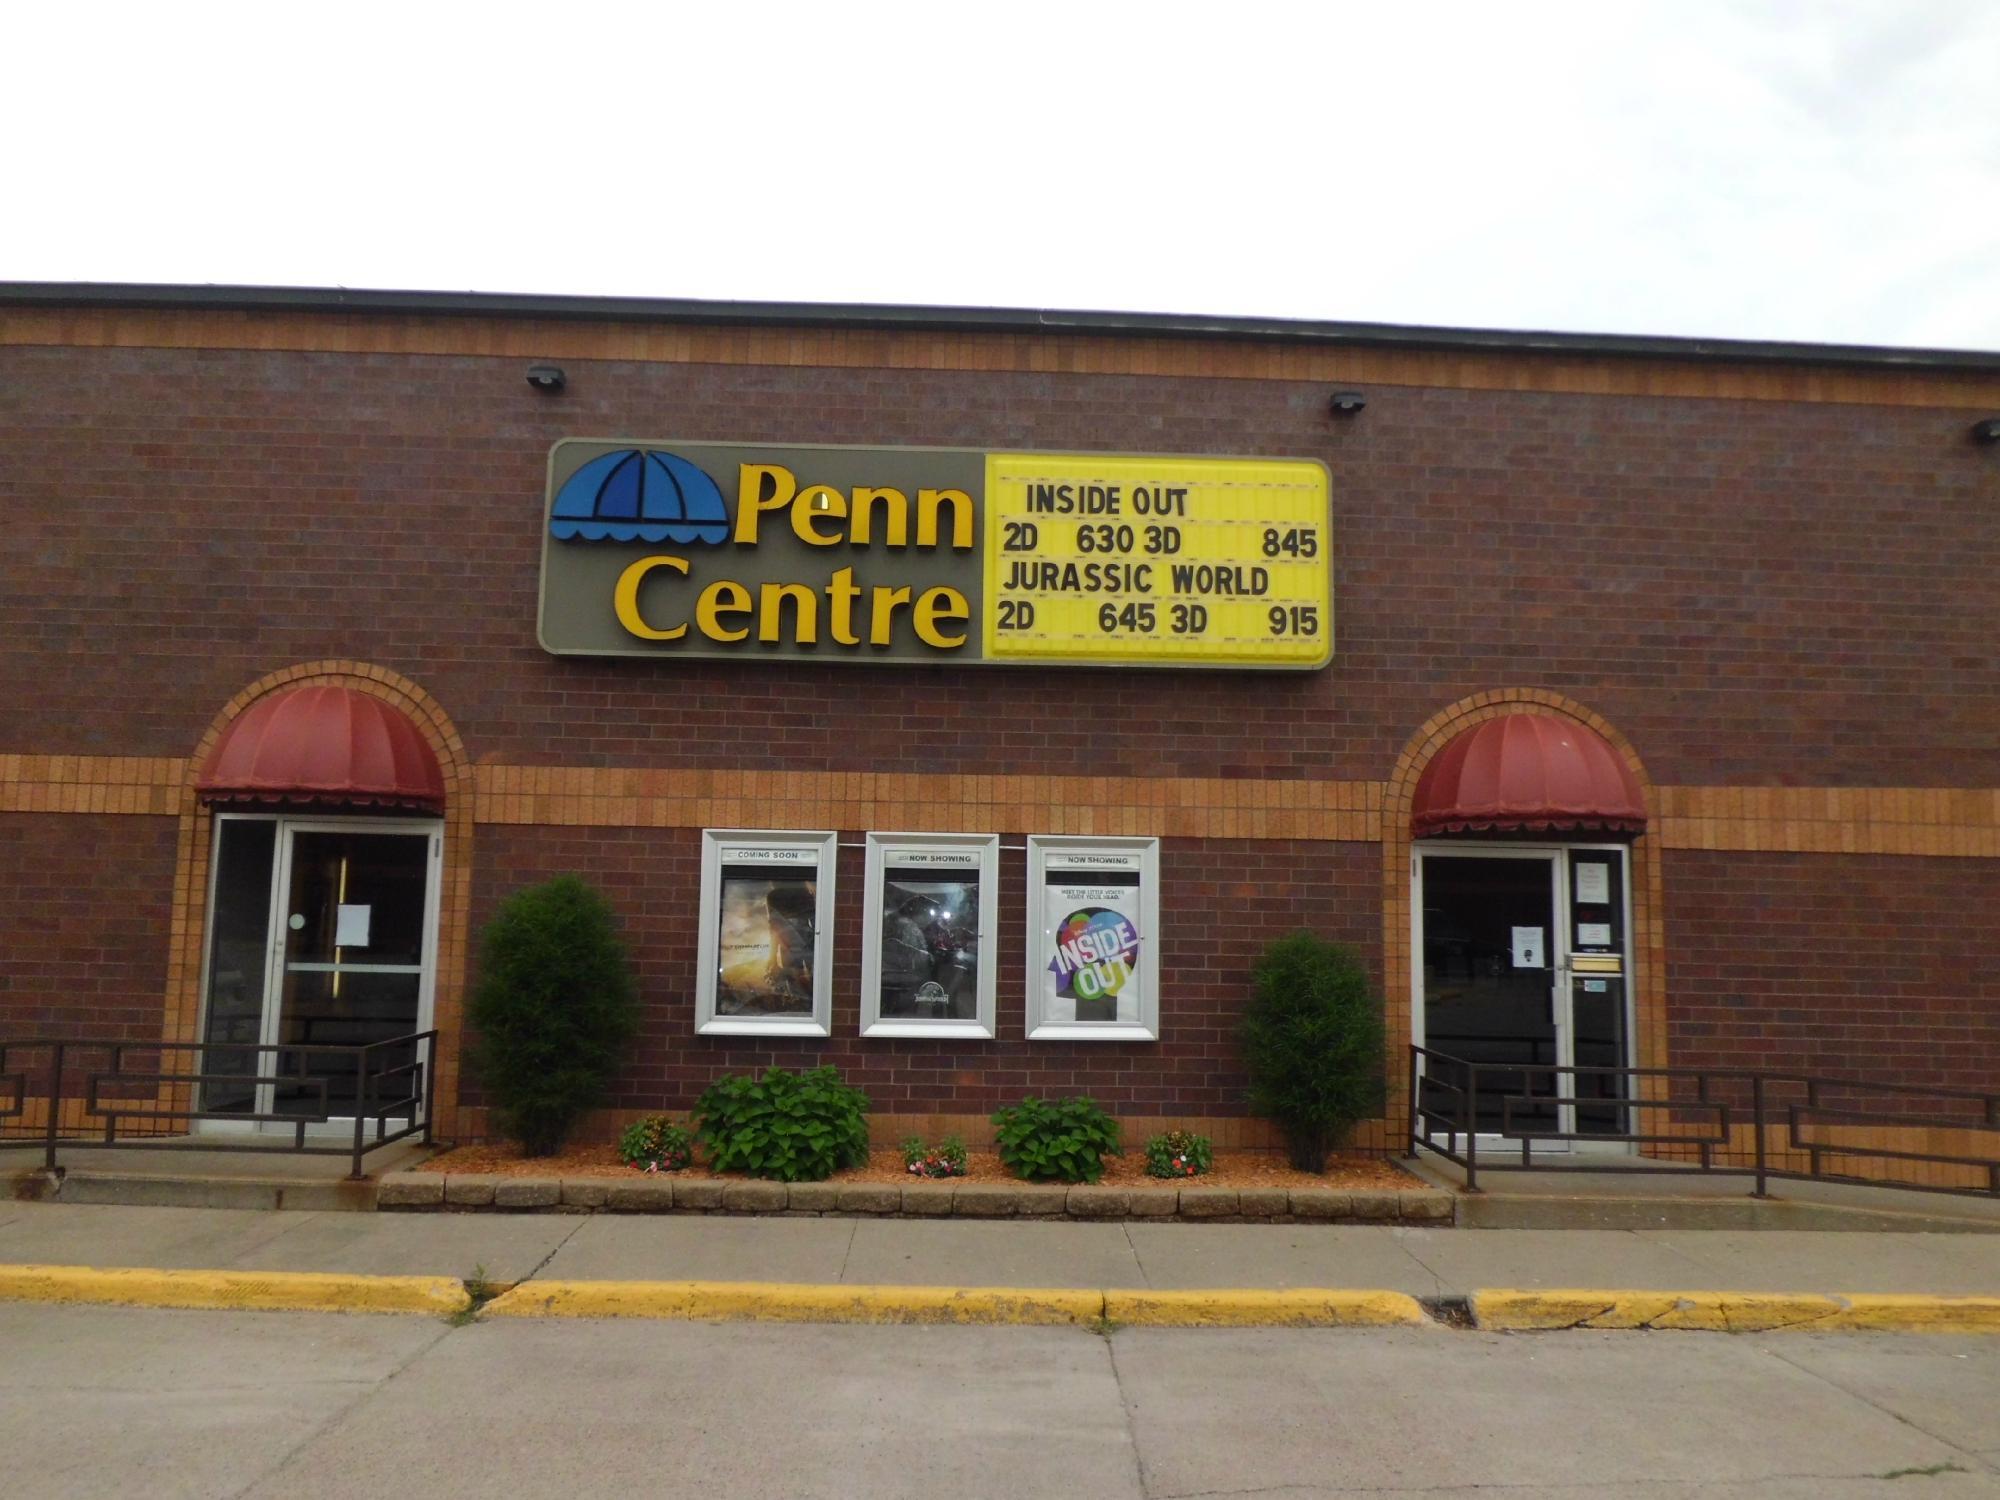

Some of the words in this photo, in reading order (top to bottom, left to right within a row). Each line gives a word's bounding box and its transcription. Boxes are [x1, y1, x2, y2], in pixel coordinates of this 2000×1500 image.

[733, 463, 974, 548] Penn
[1026, 484, 1121, 515] INSIDE
[1132, 487, 1188, 516] OUT
[1003, 522, 1038, 551] 2D
[1076, 524, 1134, 553] 630
[1143, 525, 1181, 554] 3D
[1262, 528, 1318, 558] 845
[1002, 561, 1153, 593] JURASSIC
[1171, 564, 1269, 596] WORLD
[614, 554, 970, 648] Centre
[997, 601, 1034, 630] 2D
[1098, 603, 1156, 633] 645
[1170, 605, 1208, 634] 3D
[1268, 606, 1318, 636] 915
[930, 855, 972, 863] SHOWING
[1055, 922, 1139, 976] INSIDE
[1078, 950, 1132, 996] OUT
